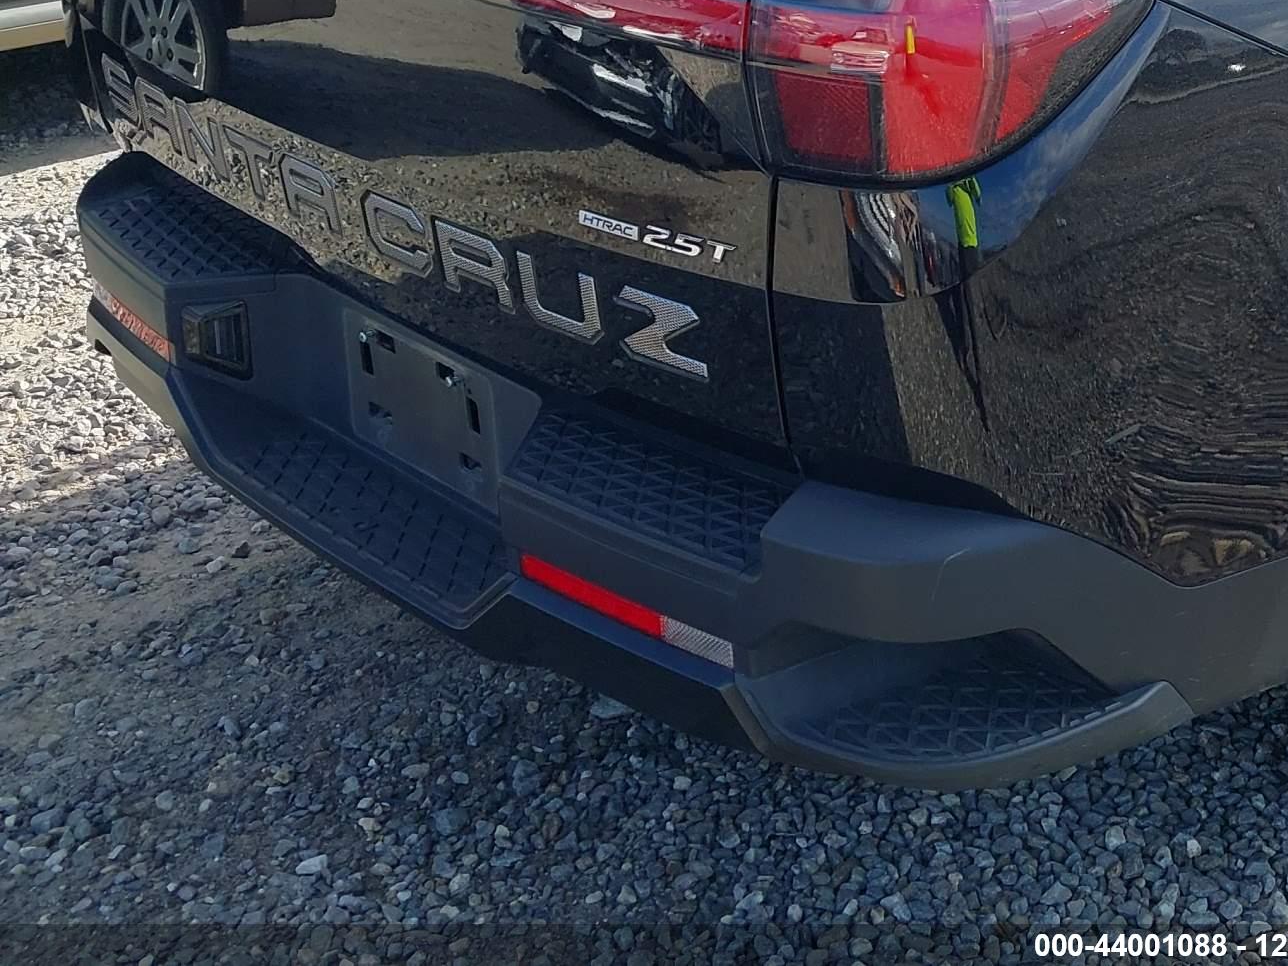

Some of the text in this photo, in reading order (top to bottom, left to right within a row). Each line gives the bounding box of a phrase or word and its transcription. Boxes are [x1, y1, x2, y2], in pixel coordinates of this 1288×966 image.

[101, 52, 710, 380] SANTA CRUZ
[583, 213, 634, 237] HTRAC
